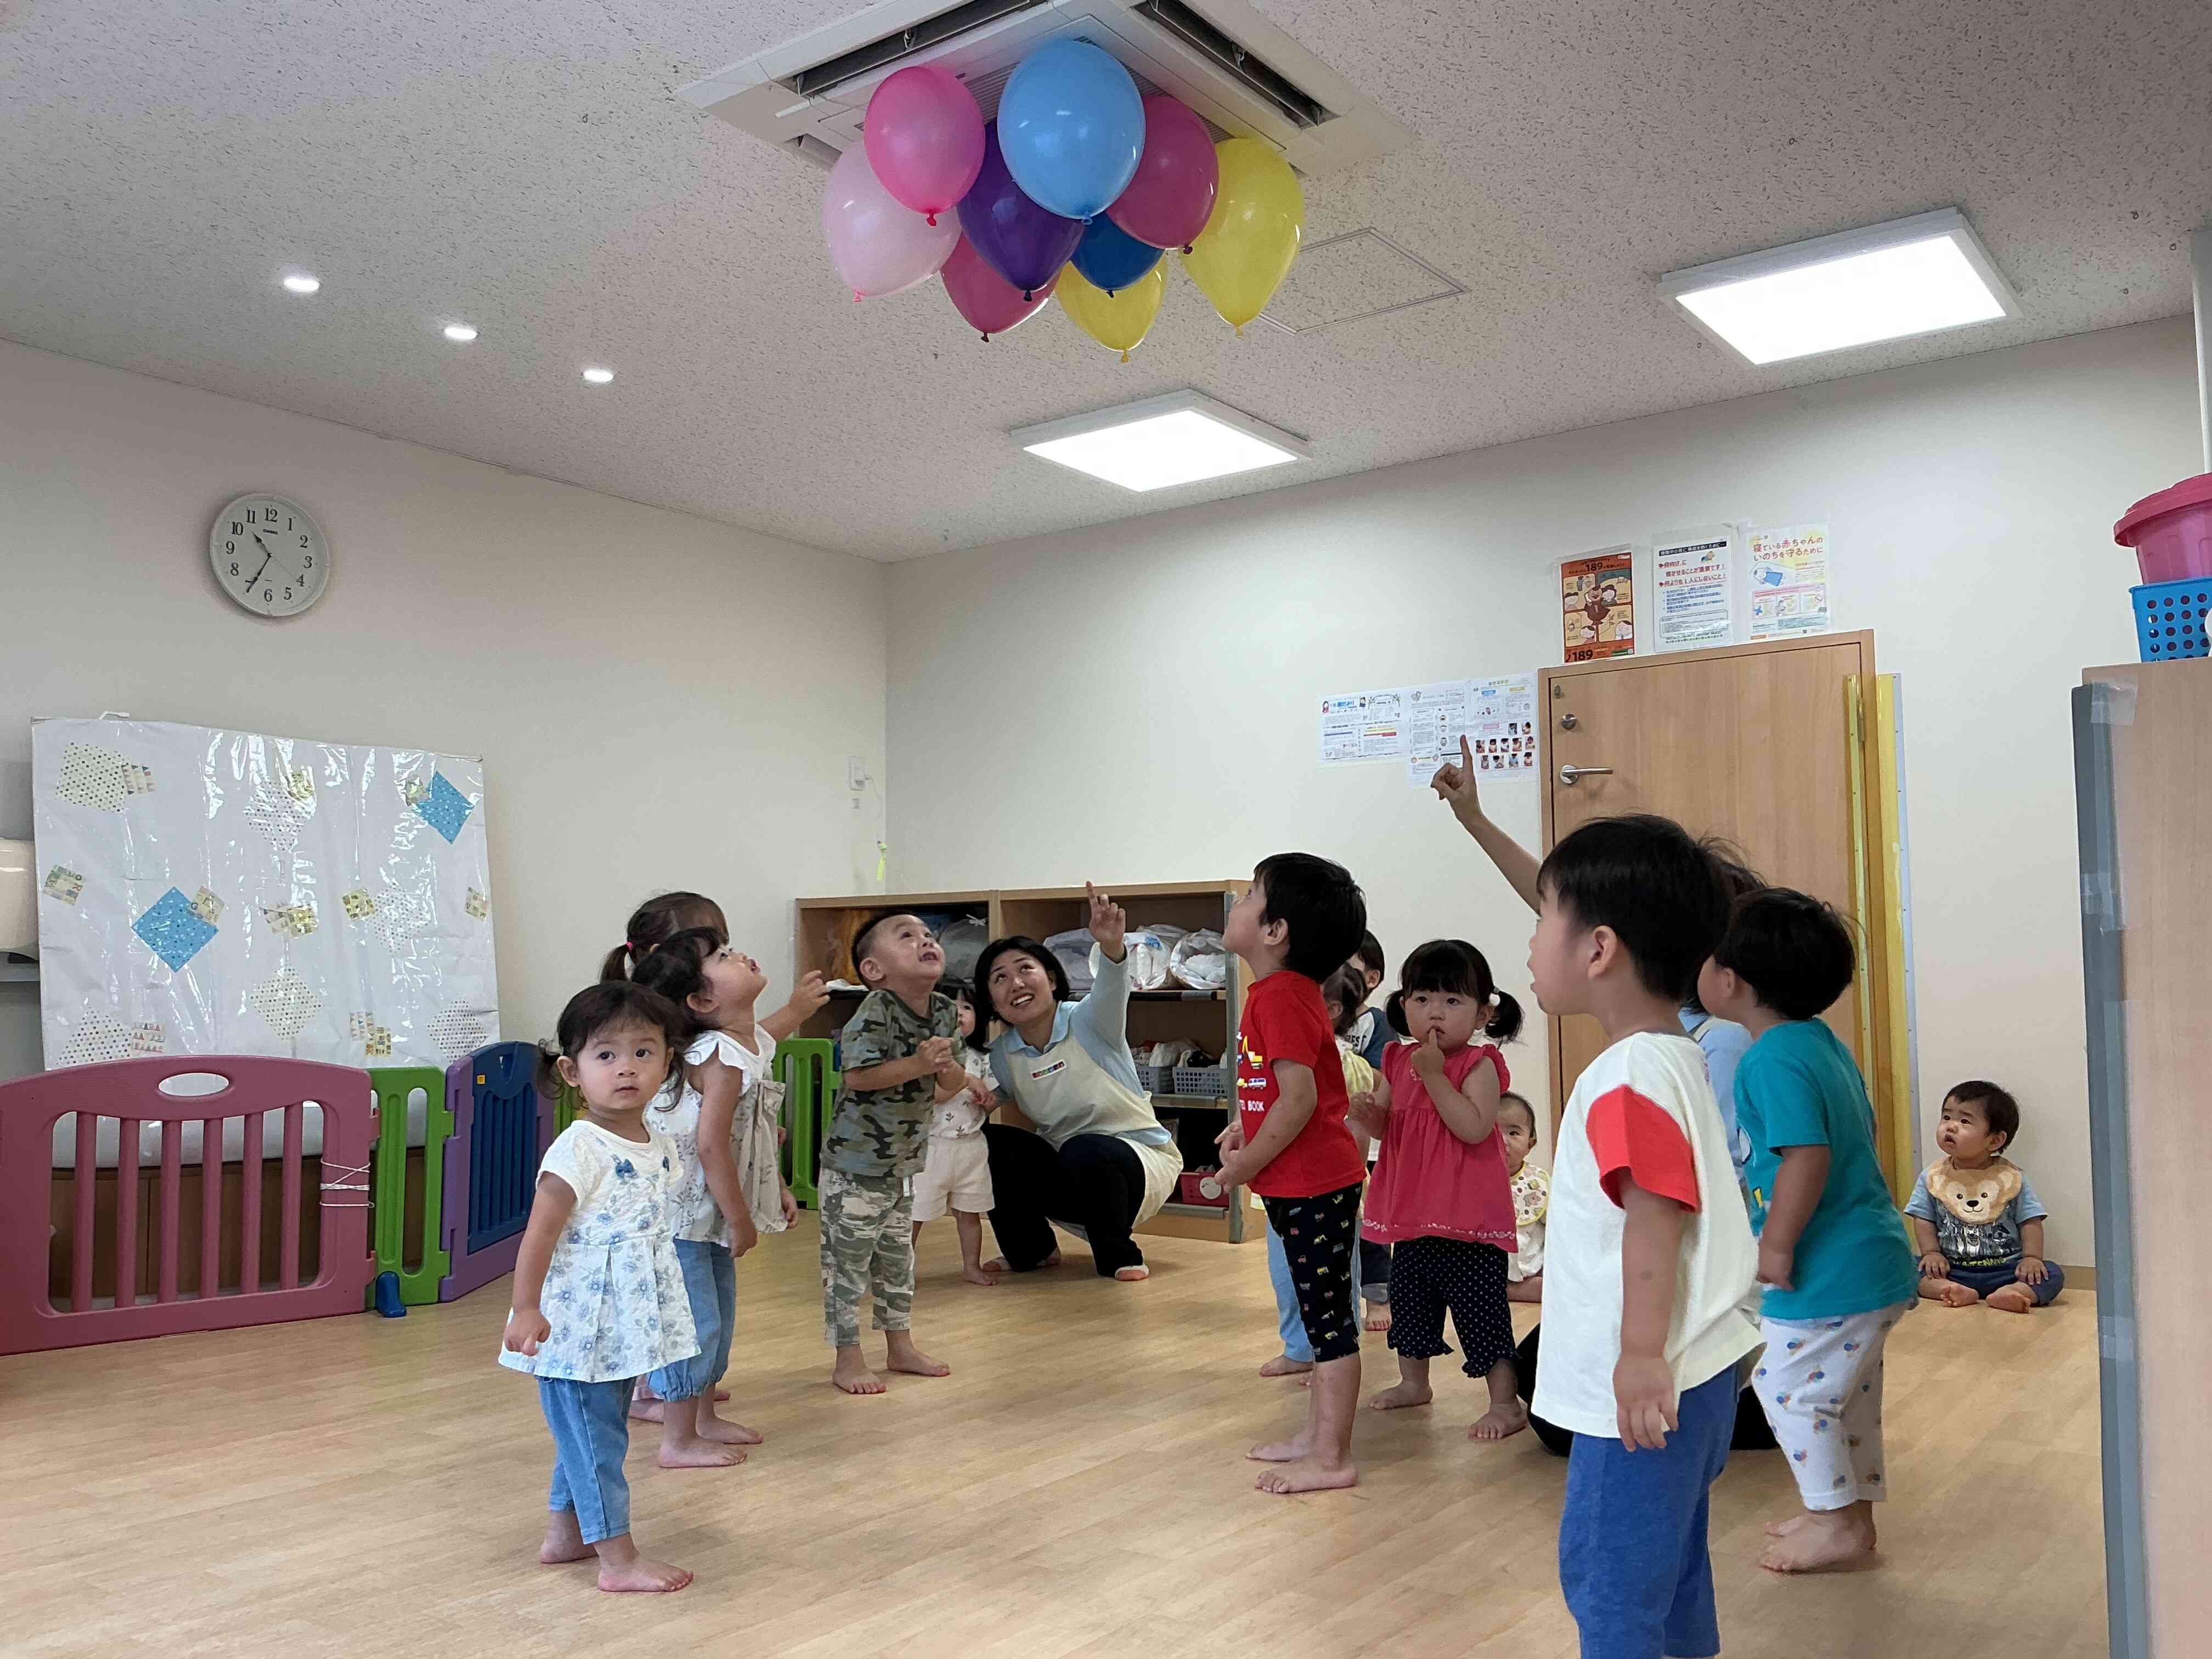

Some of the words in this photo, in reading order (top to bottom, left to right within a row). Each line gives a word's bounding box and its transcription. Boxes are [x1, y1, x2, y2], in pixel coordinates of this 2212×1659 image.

[246, 509, 256, 524] 11
[263, 507, 278, 523] 12
[231, 521, 244, 535] 10
[287, 517, 293, 531] 1
[225, 540, 235, 554] 9
[300, 535, 308, 549] 2
[1752, 536, 1823, 552] 寝ている赤ちゃんの
[1753, 547, 1823, 561] いのちを守るために
[230, 562, 239, 576] 8
[303, 556, 313, 569] 3
[1585, 562, 1603, 572] 189
[245, 579, 255, 594] 7
[296, 574, 305, 588] 4
[264, 589, 273, 602] 6
[284, 586, 292, 600] 5
[1572, 649, 1594, 662] 189
[1248, 1099, 1265, 1112] BOOK
